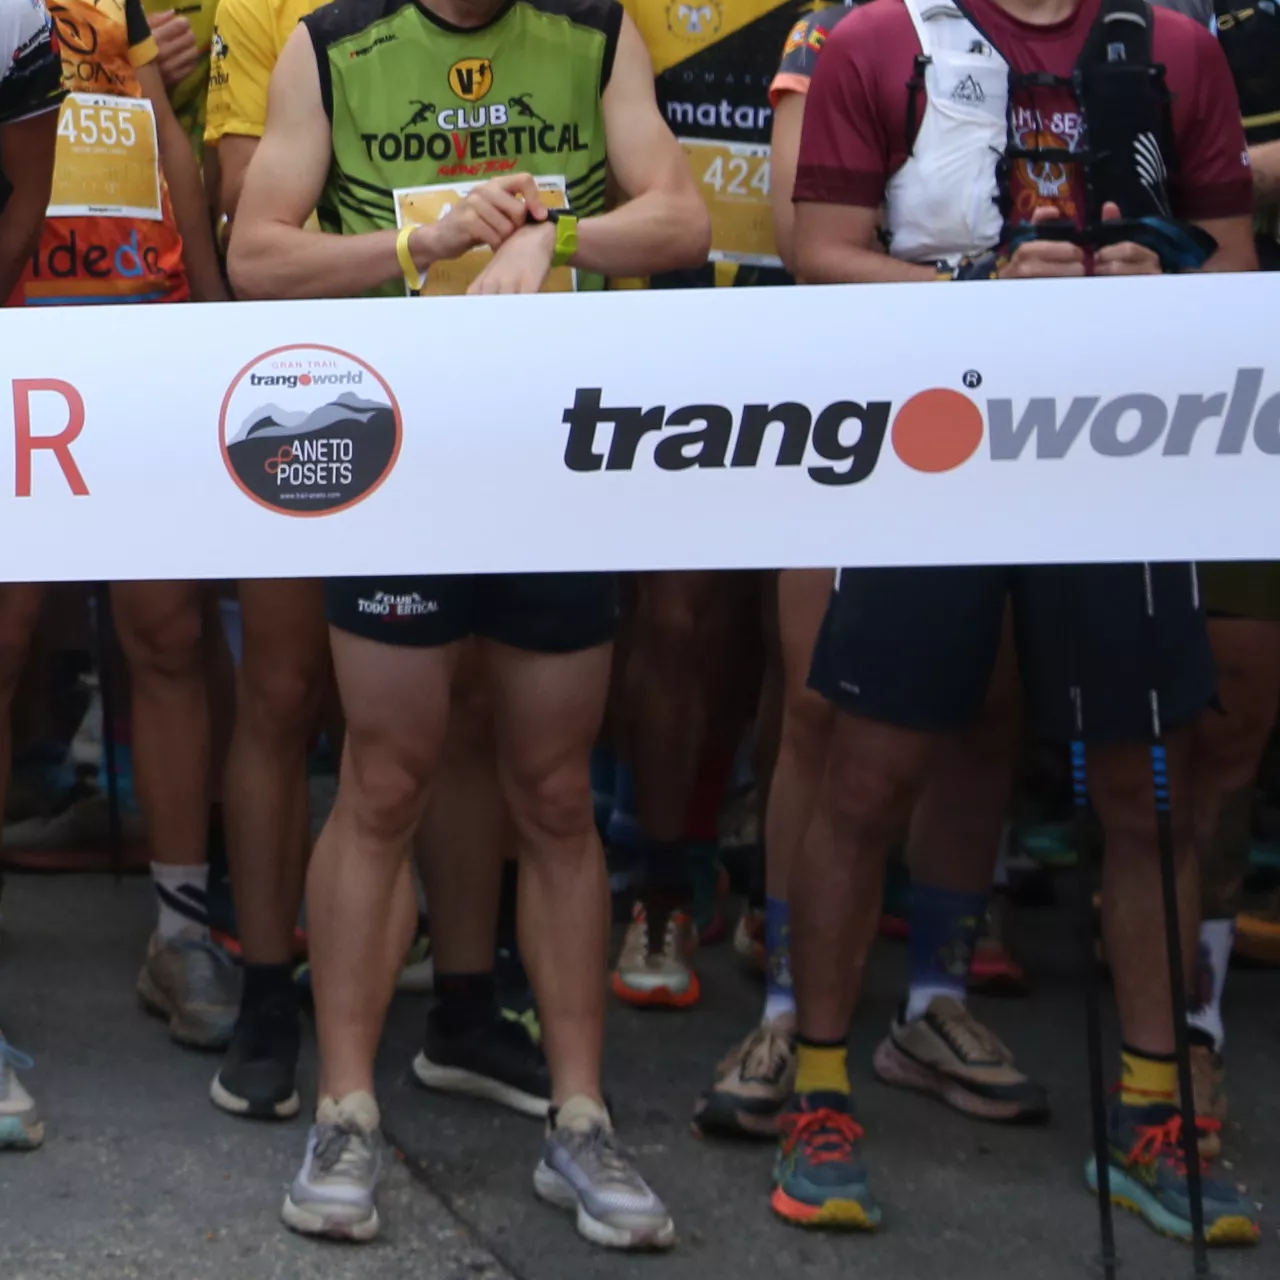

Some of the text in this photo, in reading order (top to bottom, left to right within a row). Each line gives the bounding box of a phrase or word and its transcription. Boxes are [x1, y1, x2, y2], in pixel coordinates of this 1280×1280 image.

[57, 106, 136, 147] 4555
[437, 103, 509, 130] CLUB
[361, 123, 589, 163] TODOVERTICAL
[271, 360, 339, 370] GRAN TRAIL
[292, 438, 353, 462] ANETO
[277, 463, 353, 486] POSETS
